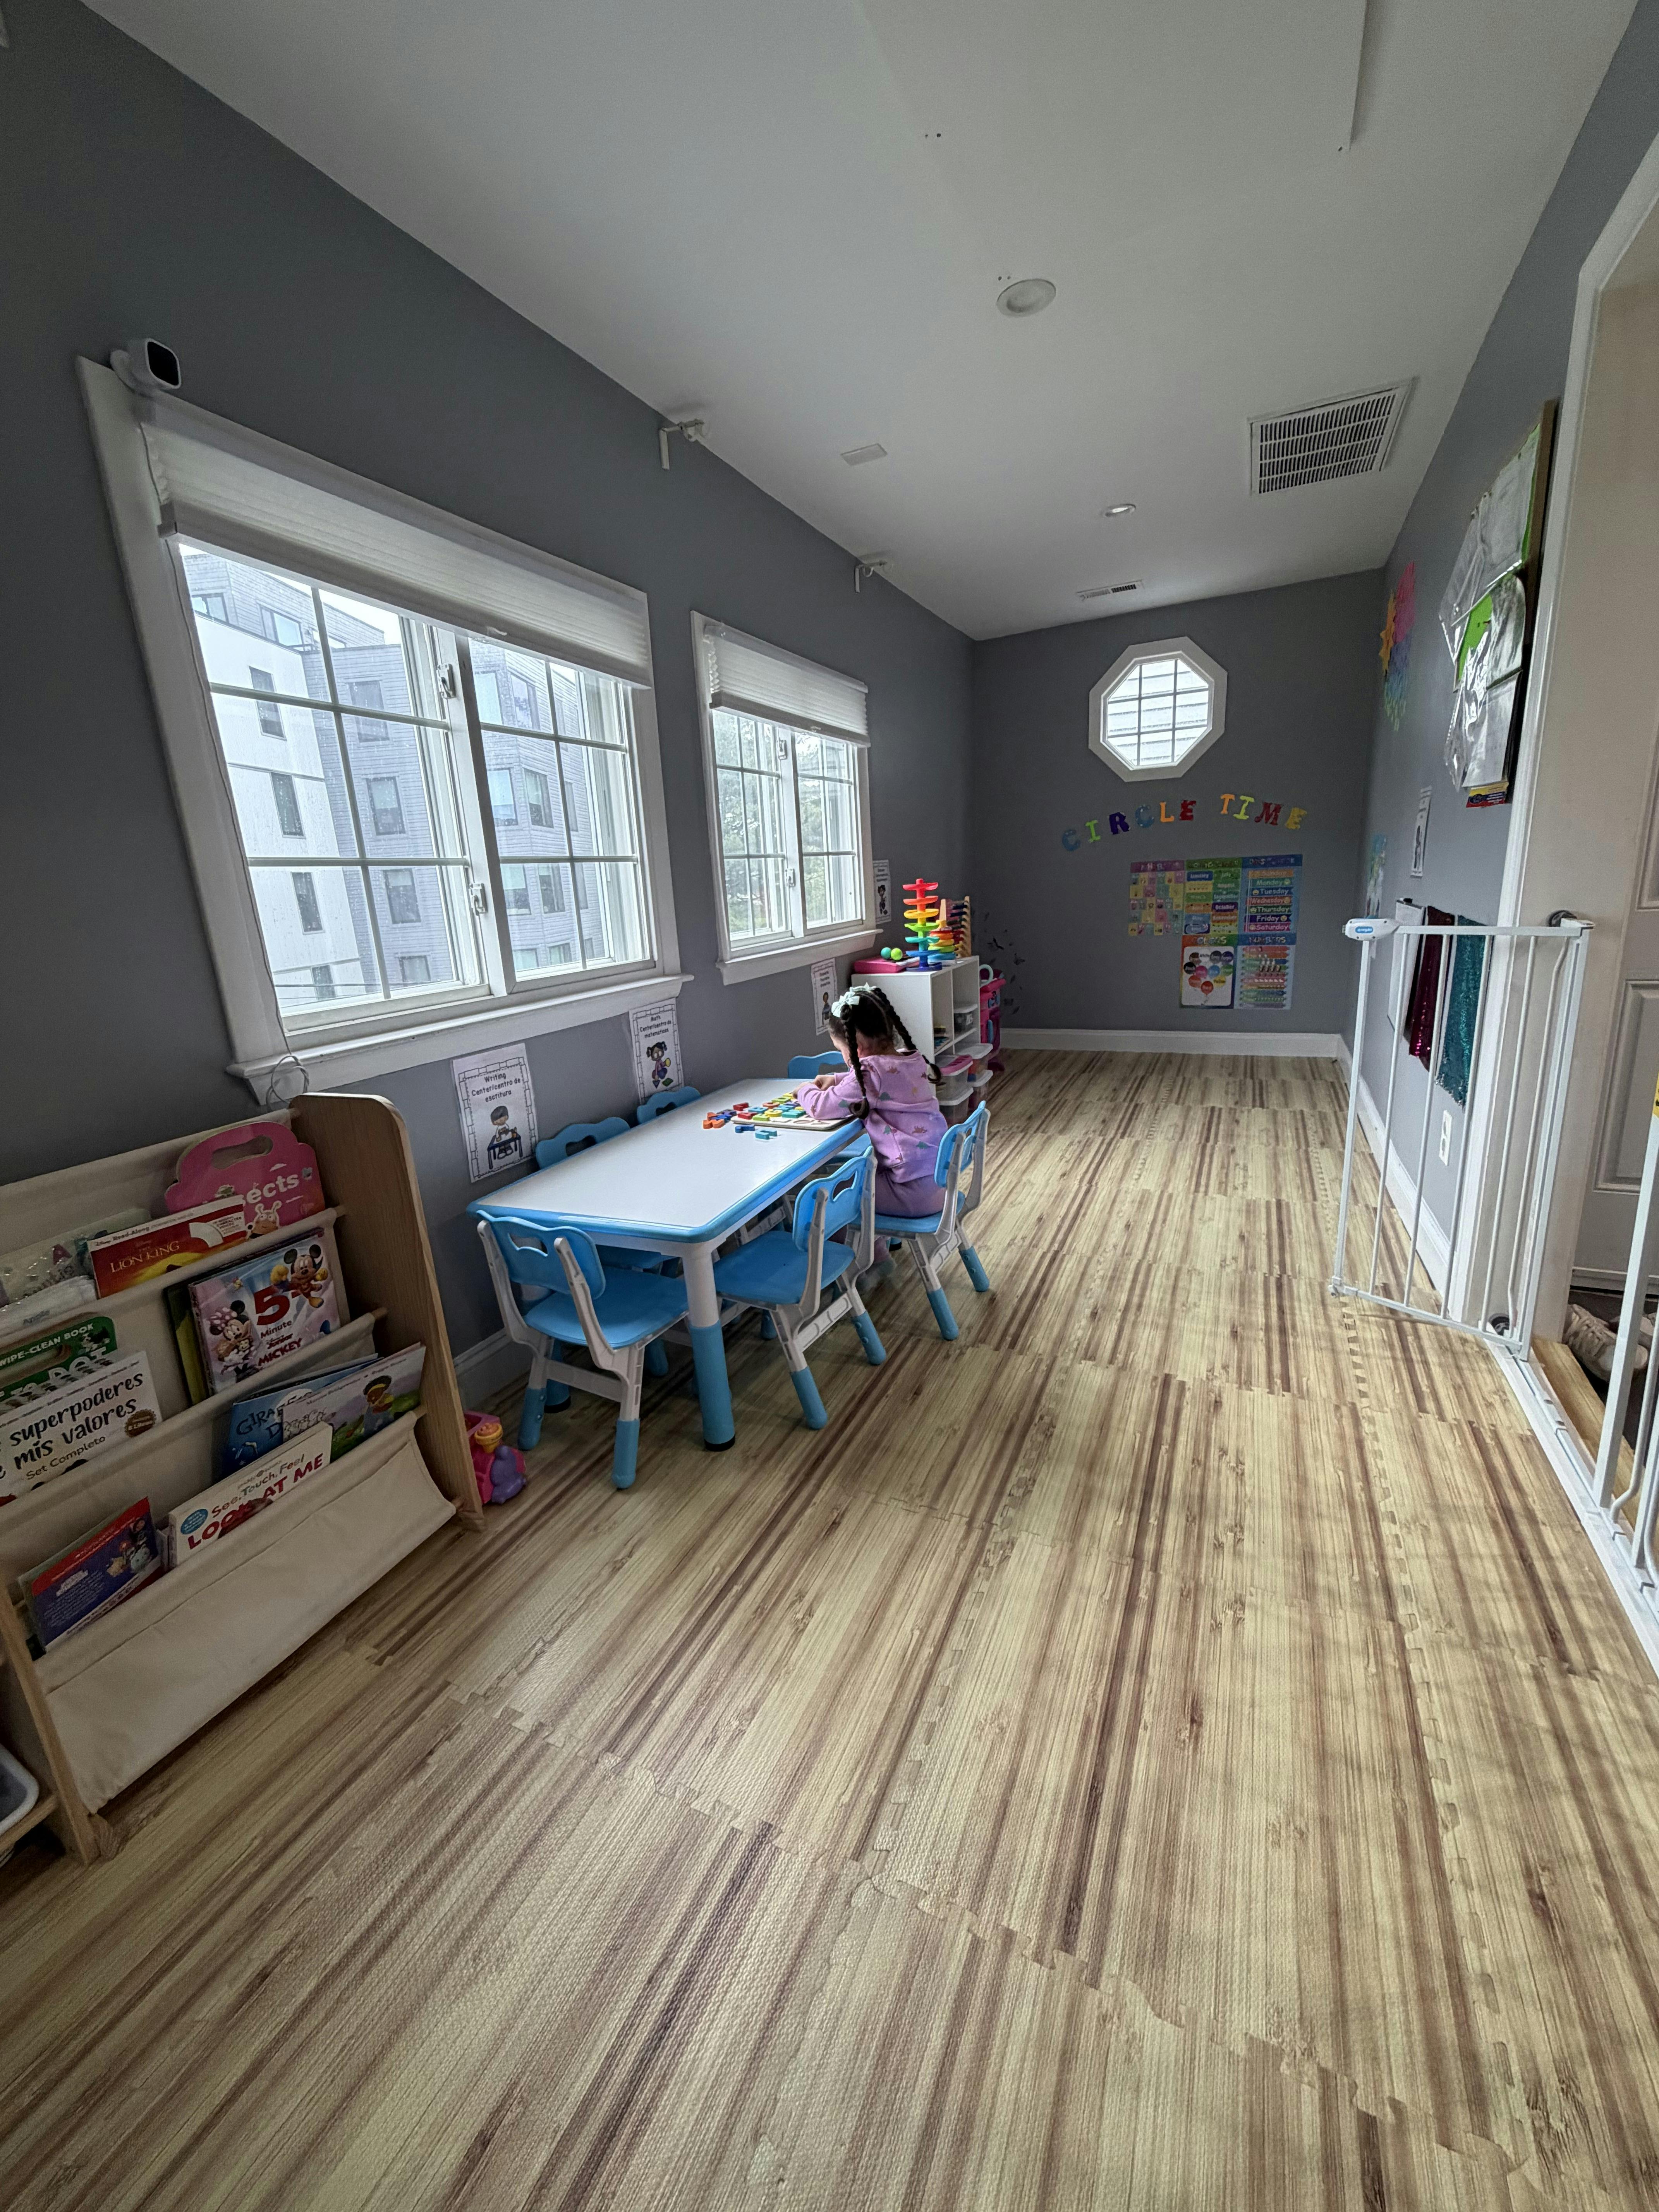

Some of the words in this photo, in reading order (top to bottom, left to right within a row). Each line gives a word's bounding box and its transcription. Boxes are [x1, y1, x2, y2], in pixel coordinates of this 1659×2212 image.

[1061, 799, 1197, 852] CIRCLE
[1220, 793, 1307, 830] TIME
[471, 1080, 513, 1096] Center/centro
[484, 1073, 507, 1082] Writing
[485, 1090, 512, 1102] escritura
[244, 1174, 300, 1204] ects
[110, 1254, 143, 1273] LION
[146, 1240, 180, 1260] KING
[0, 1337, 60, 1366] WIPE-CLEAN
[64, 1323, 93, 1340] BOOK
[261, 1320, 292, 1338] Minute
[258, 1337, 302, 1366] MICKEY
[10, 1373, 143, 1446] superpoderes
[14, 1440, 53, 1470] mis
[62, 1398, 136, 1444] valores
[26, 1465, 48, 1480] Set
[50, 1436, 105, 1467] Completo
[280, 1453, 305, 1474] Feel
[263, 1475, 288, 1498] AT
[294, 1453, 323, 1483] ME
